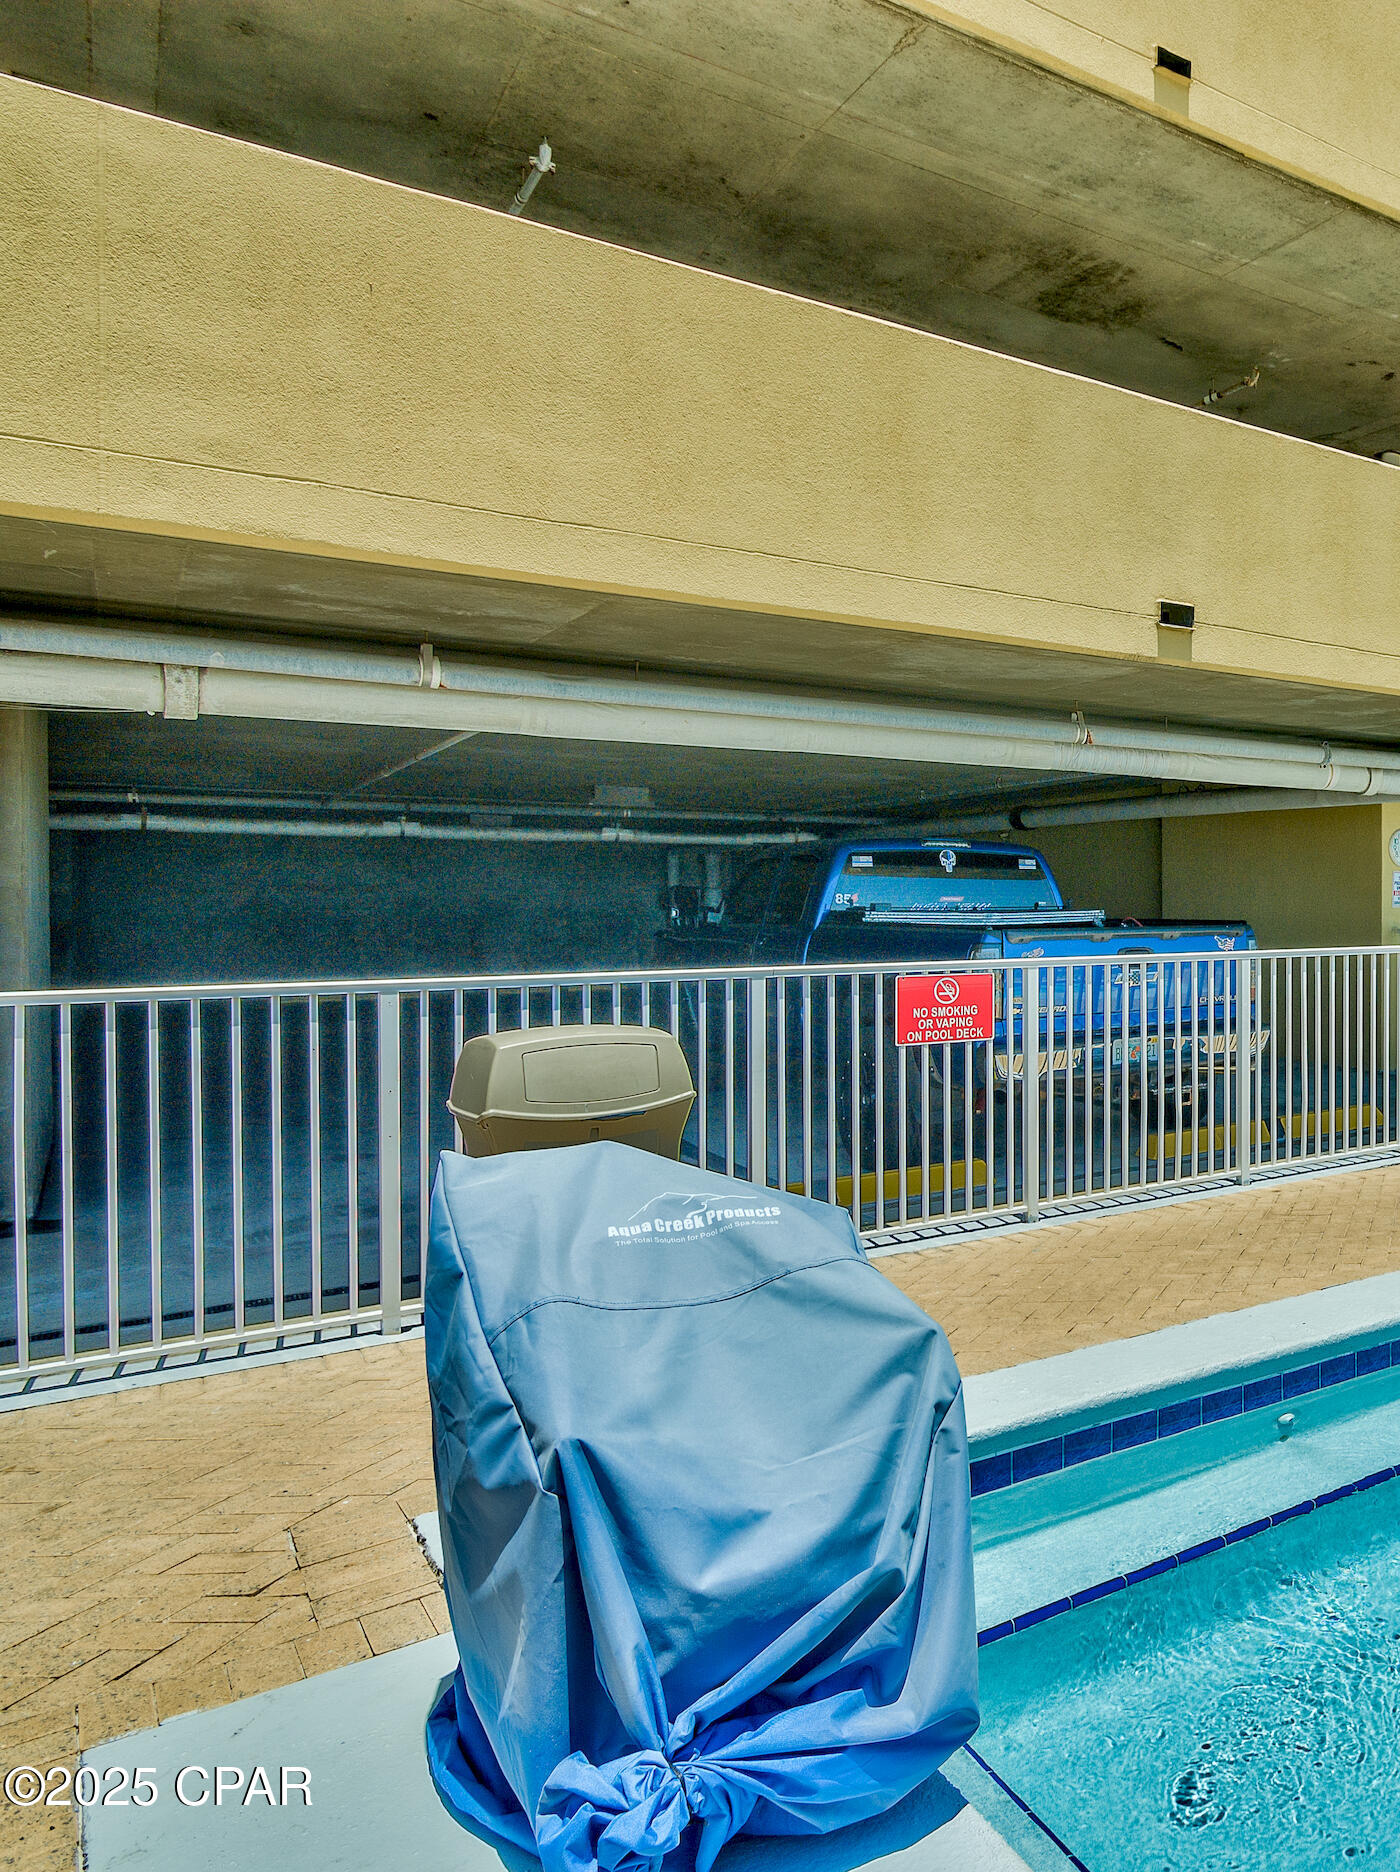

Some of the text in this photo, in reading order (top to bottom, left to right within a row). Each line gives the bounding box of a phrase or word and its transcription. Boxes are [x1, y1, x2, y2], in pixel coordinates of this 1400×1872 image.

[913, 1005, 978, 1018] NO SMOKING
[918, 1016, 973, 1029] OR VAPING
[907, 1027, 984, 1042] ON POOL DECK
[608, 1206, 781, 1237] Aqua Creek Products
[616, 1239, 632, 1247] The
[632, 1236, 653, 1244] Total
[654, 1236, 686, 1244] Solution
[687, 1234, 698, 1242] for
[700, 1228, 718, 1239] Pool
[719, 1223, 733, 1233] and
[734, 1219, 750, 1228] Spa
